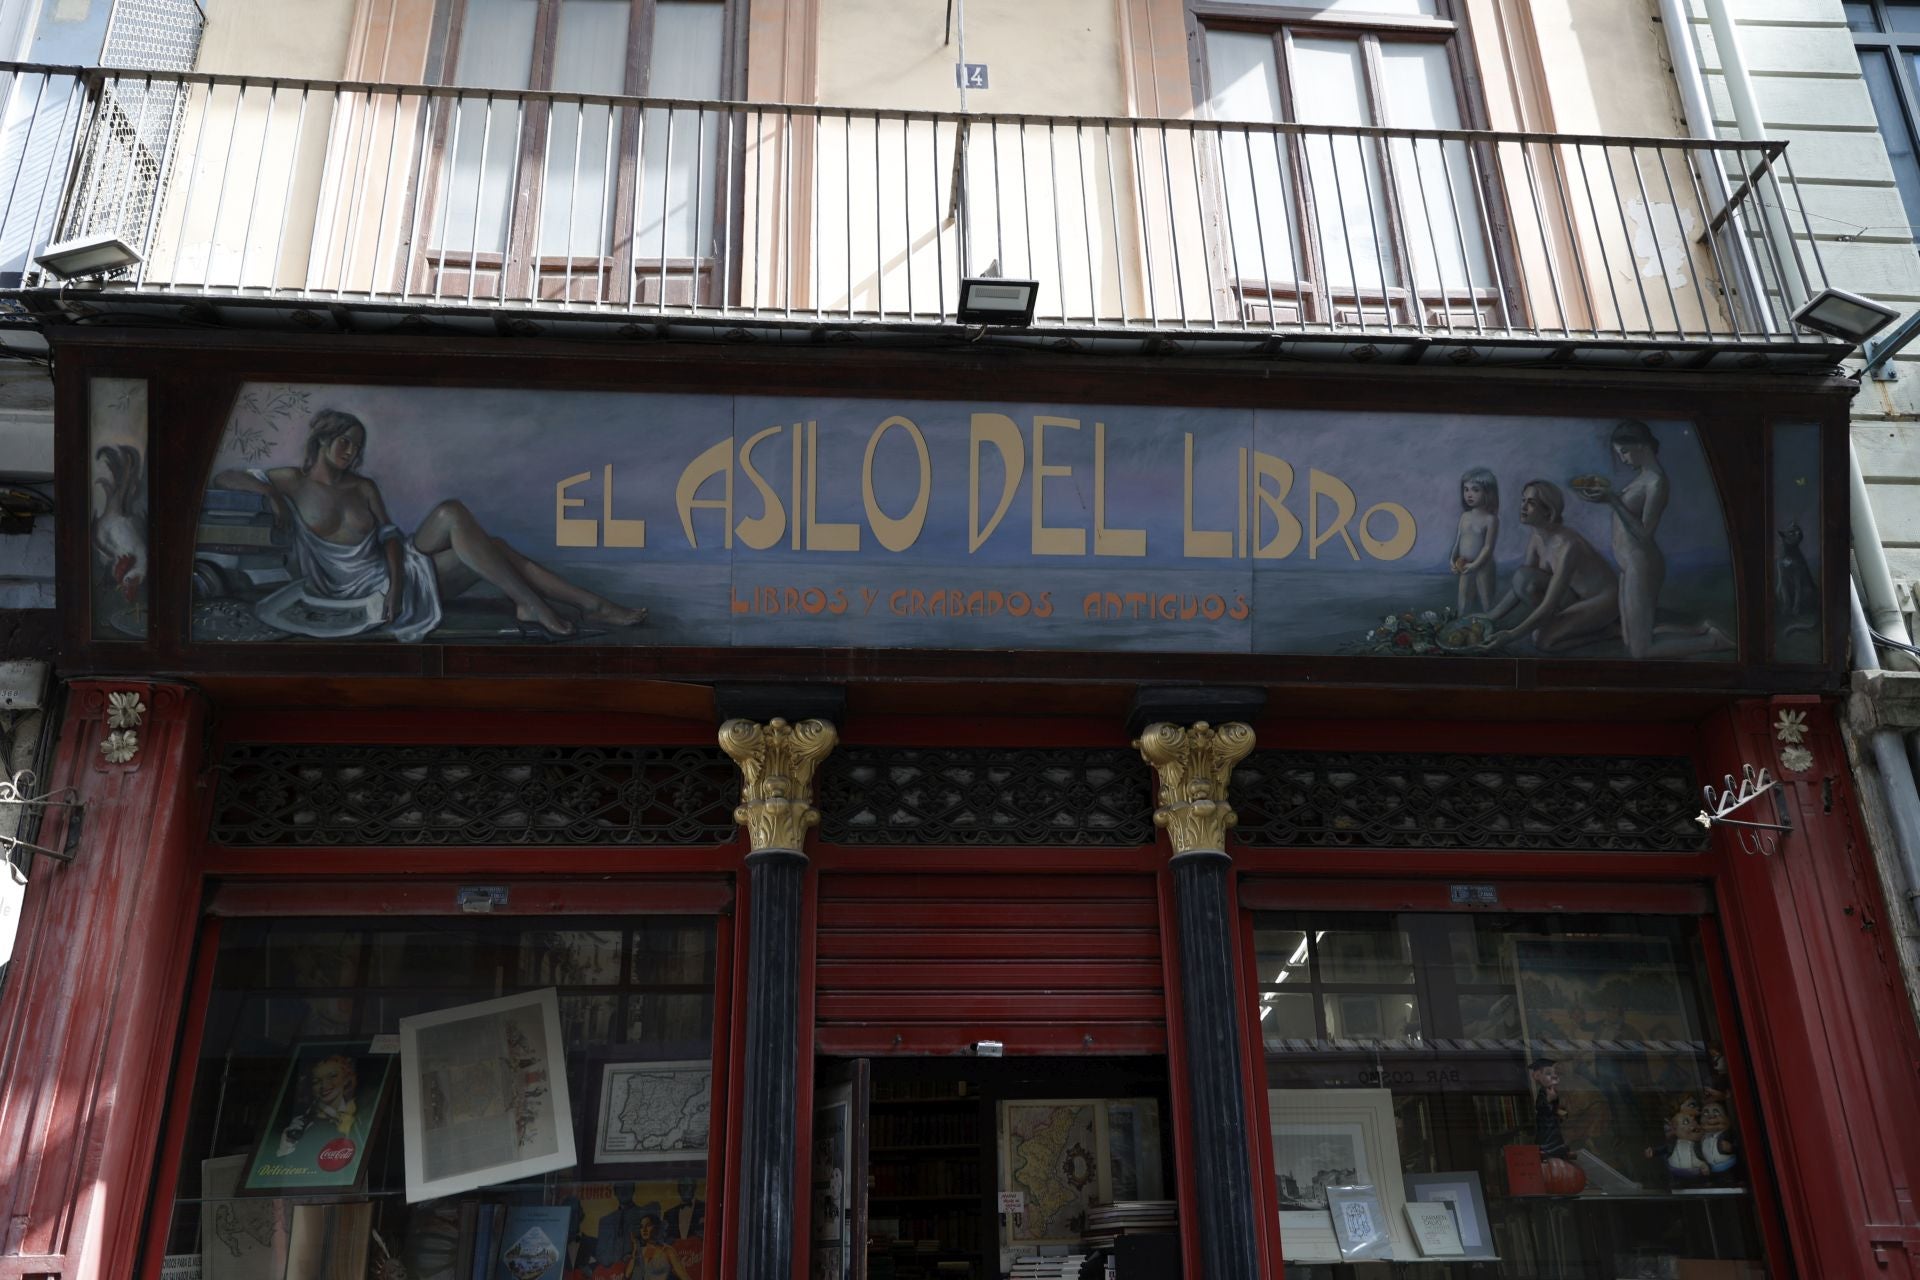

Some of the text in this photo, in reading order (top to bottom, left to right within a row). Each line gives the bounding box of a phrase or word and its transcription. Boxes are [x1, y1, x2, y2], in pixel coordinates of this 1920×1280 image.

[961, 66, 983, 86] 14
[556, 413, 1416, 561] EL ASILO DEL LIBRO
[730, 586, 1250, 621] LIBROS Y GRABADOS ANTIGUOS
